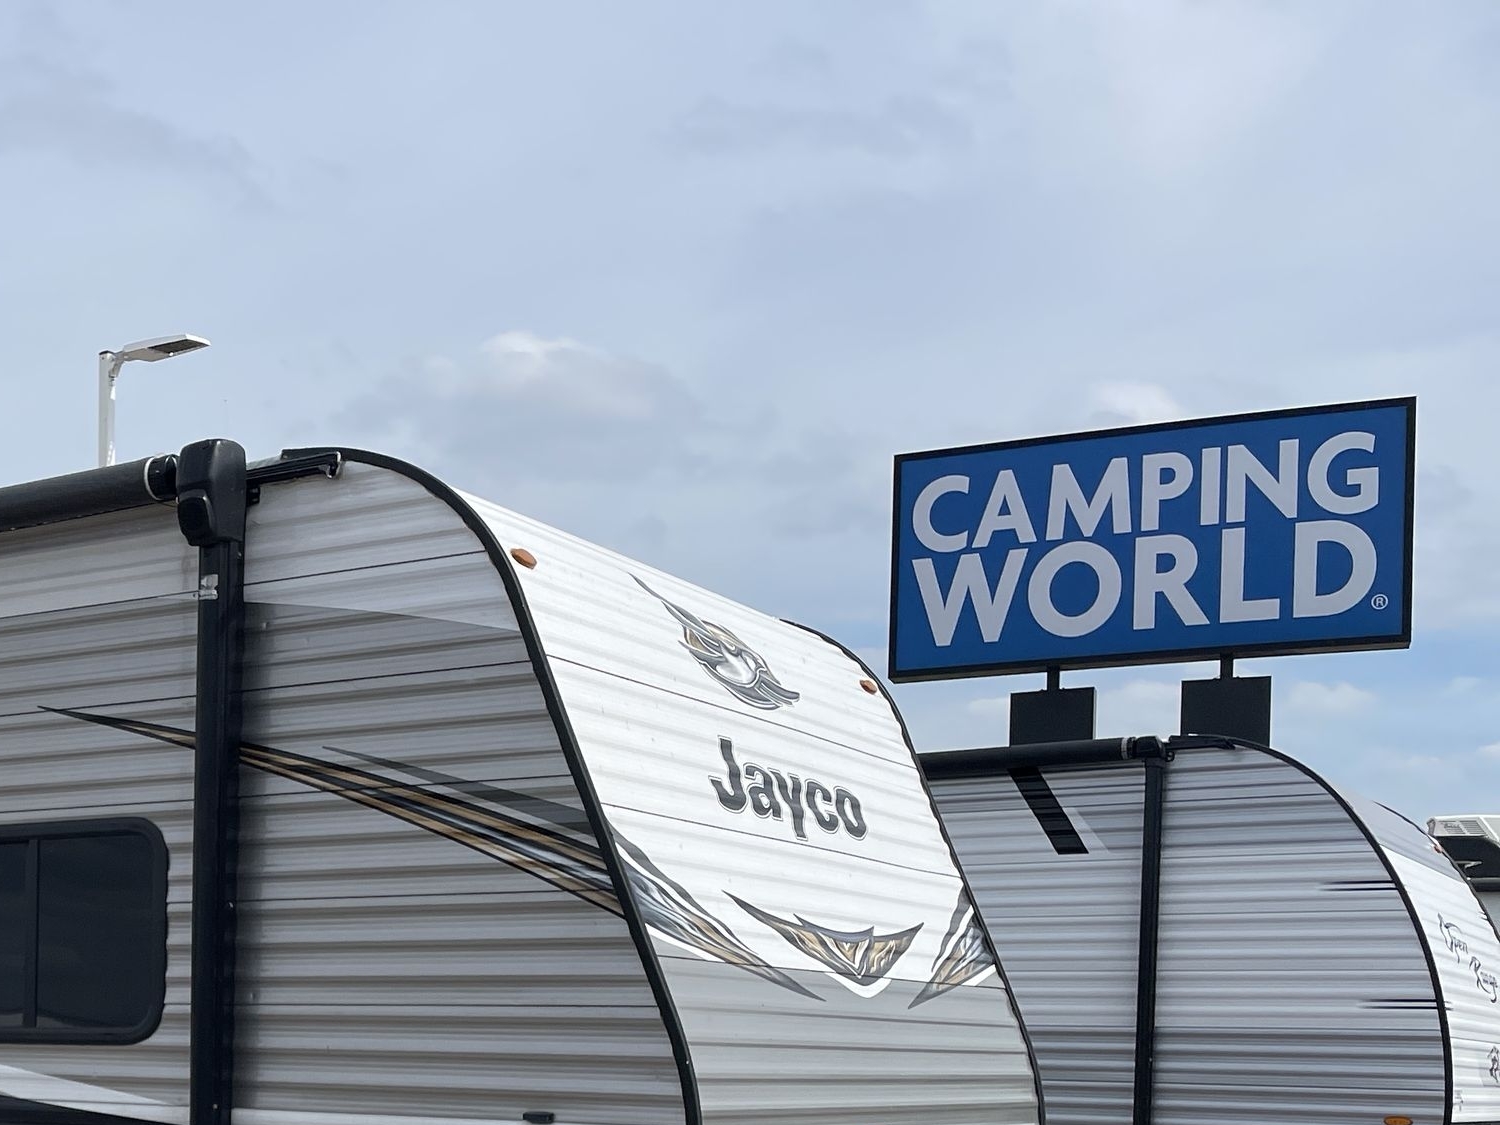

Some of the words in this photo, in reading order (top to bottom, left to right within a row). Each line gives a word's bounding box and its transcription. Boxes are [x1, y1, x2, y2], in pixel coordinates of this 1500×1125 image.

[912, 431, 1380, 553] CAMPING
[912, 519, 1378, 647] WORLD
[708, 734, 869, 842] Jayco
